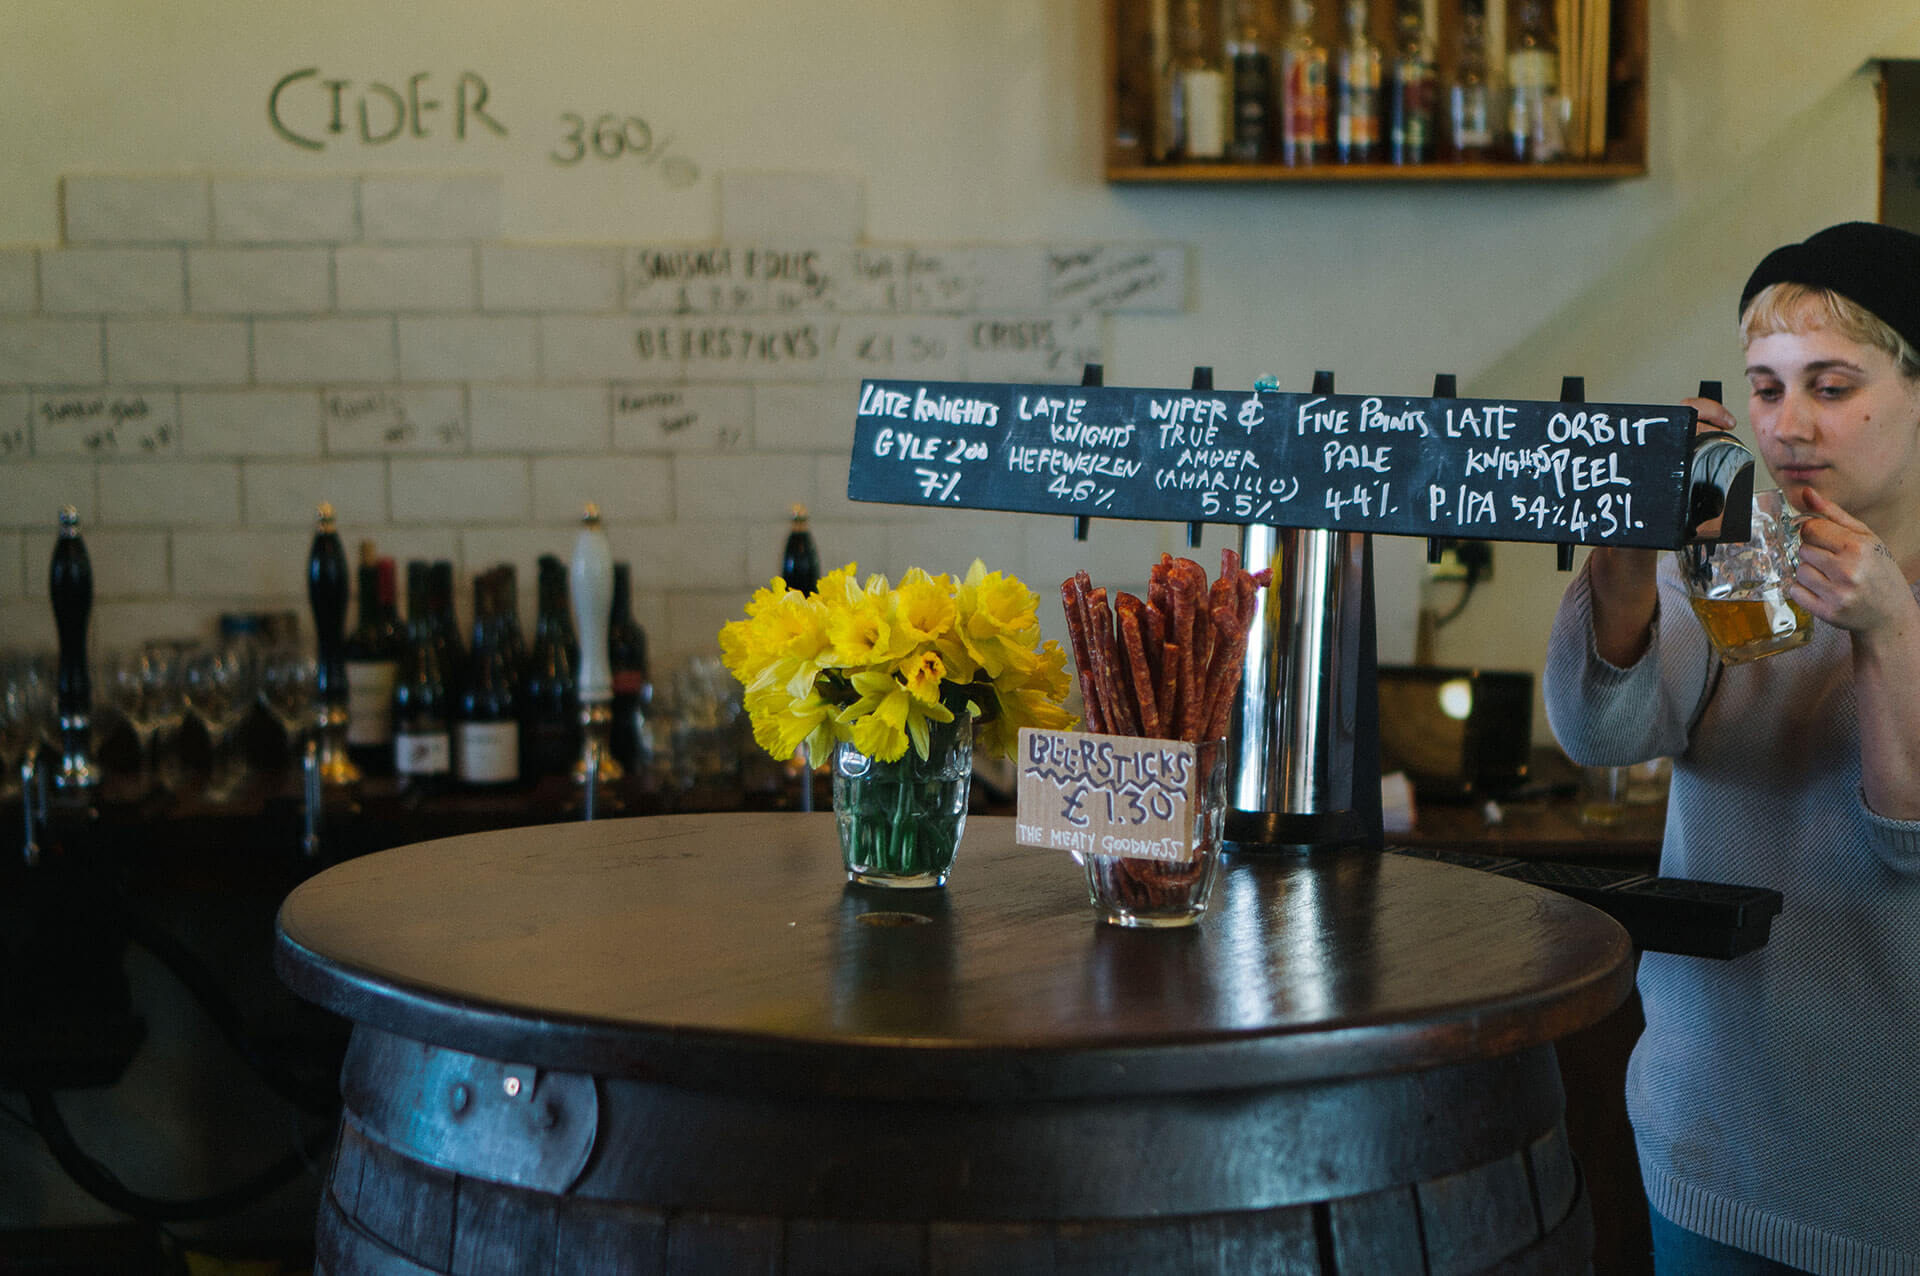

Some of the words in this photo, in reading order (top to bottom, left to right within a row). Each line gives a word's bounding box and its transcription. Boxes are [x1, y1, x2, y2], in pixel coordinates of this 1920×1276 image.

[268, 67, 508, 151] CIDER
[859, 384, 912, 418] LATE
[1018, 396, 1087, 423] LATE
[1150, 398, 1228, 426] WIPER
[1237, 392, 1265, 435] &
[1298, 397, 1349, 436] FIVE
[1051, 422, 1136, 448] KNIGHTS
[1159, 423, 1219, 449] TRUE
[1446, 405, 1518, 440] LATE
[1547, 411, 1669, 447] ORBIT
[874, 428, 942, 460] GYLE
[1176, 448, 1260, 472] AMBER
[1323, 440, 1393, 473] PALE
[1008, 446, 1142, 478] HEFEWEIZEN
[1550, 448, 1632, 499] PEEL
[914, 468, 962, 501] 7%
[1047, 474, 1116, 510] 4.6%
[1155, 468, 1299, 503] (AMARILLO)
[1201, 491, 1275, 521] 5.5%
[1511, 494, 1568, 530] 5.4%
[1570, 493, 1644, 542] 4.3%
[1029, 733, 1194, 789] BEERSTICKS
[1019, 825, 1043, 845] THE
[1050, 829, 1096, 851] MEATY
[1102, 835, 1185, 859] GOODNESS
